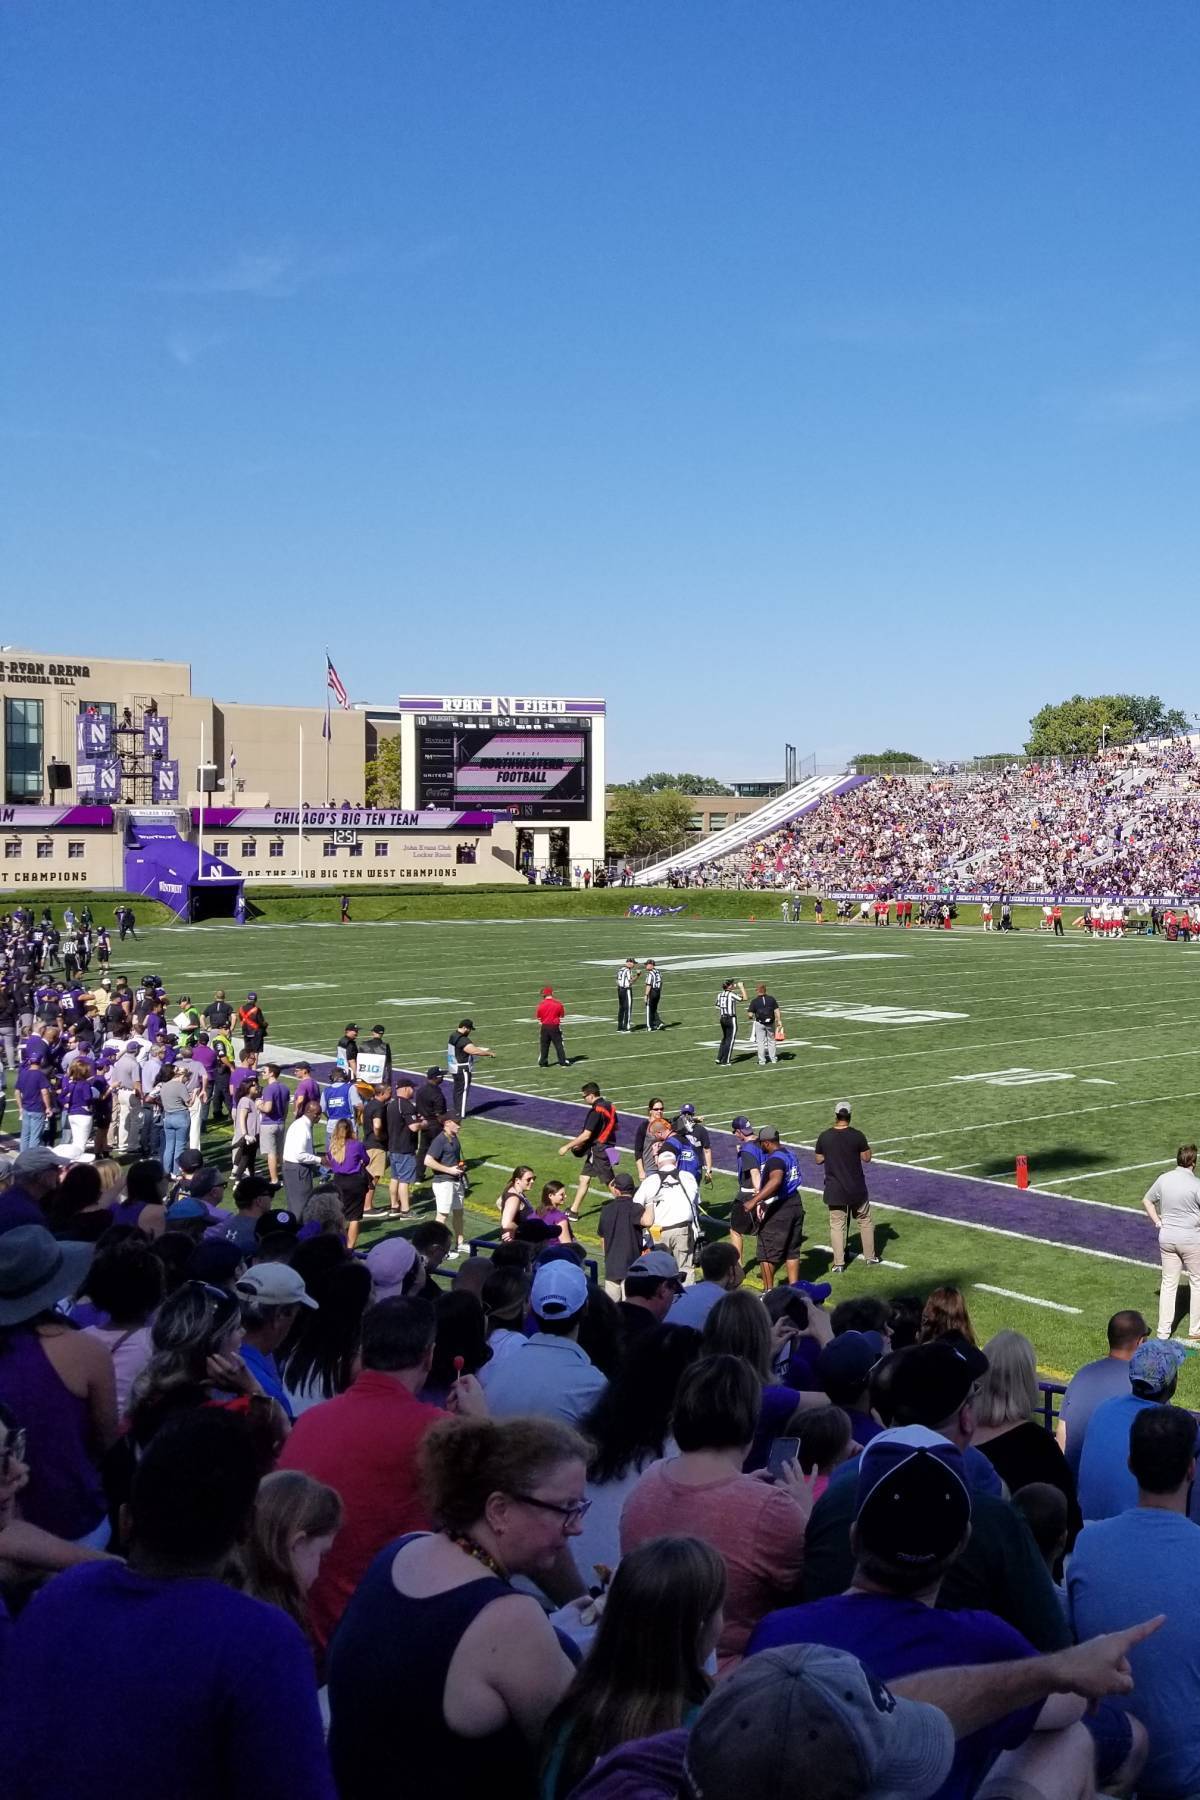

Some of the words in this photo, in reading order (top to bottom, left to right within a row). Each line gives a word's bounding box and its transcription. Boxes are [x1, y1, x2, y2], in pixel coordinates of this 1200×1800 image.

[48, 663, 91, 678] ARENA
[7, 673, 52, 685] MEMORIAL
[53, 676, 76, 686] HALL
[442, 698, 483, 712] RYAN
[523, 700, 566, 714] FIELD
[91, 723, 106, 744] N
[149, 726, 163, 746] N
[479, 758, 565, 770] NORTHWESTERN
[101, 768, 116, 789] N
[159, 770, 174, 791] N
[496, 771, 547, 783] FOOTBALL
[274, 811, 338, 825] CHICAGO'S
[341, 812, 361, 825] BIG
[365, 813, 386, 825] TEN
[390, 813, 419, 826] TEAM
[336, 830, 353, 843] 25
[14, 872, 87, 882] CHAMPIONS
[211, 865, 222, 881] N
[320, 869, 338, 878] BIG
[343, 869, 363, 878] TEN
[367, 869, 396, 878] WEST
[399, 868, 457, 877] CHAMPIONS
[61, 997, 75, 1009] 93
[949, 1067, 1077, 1087] 10
